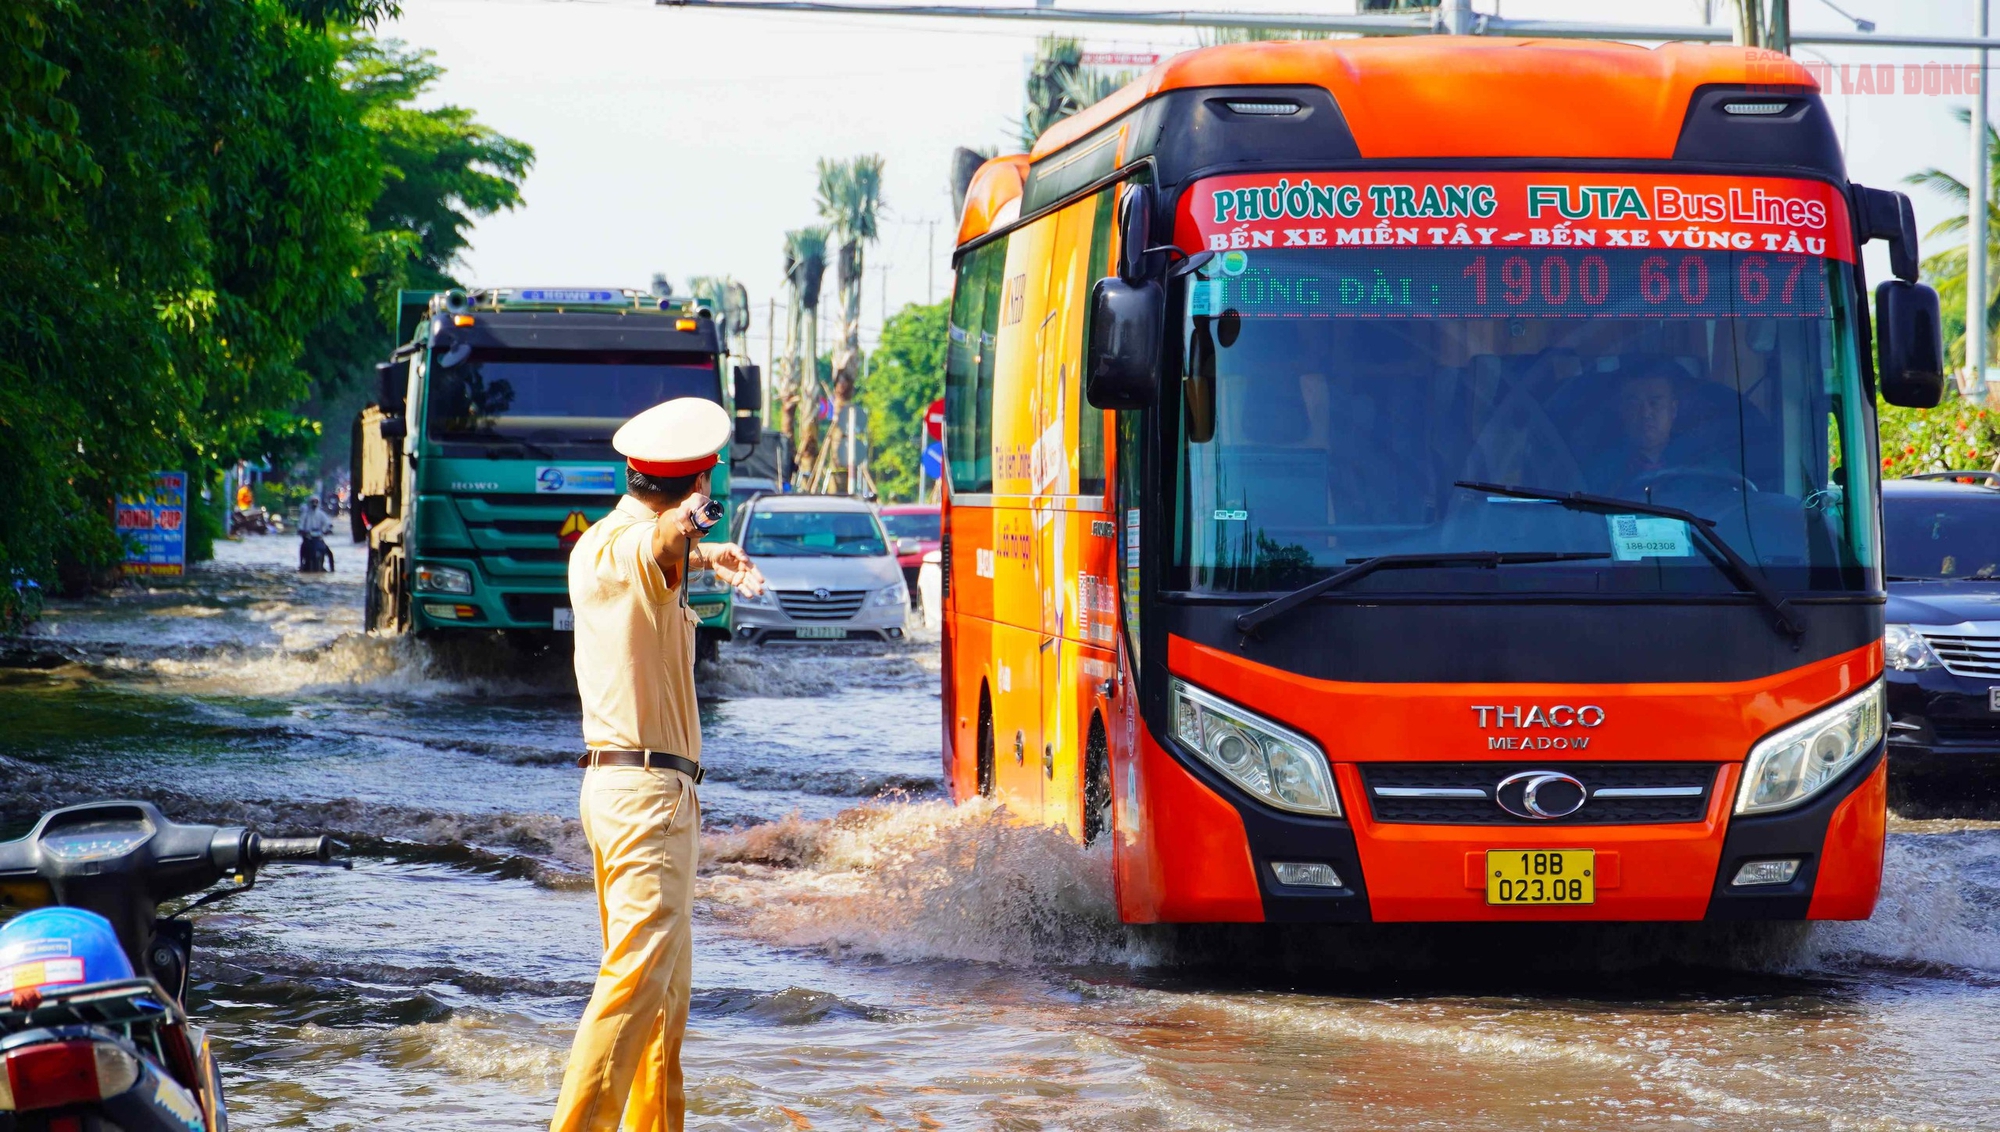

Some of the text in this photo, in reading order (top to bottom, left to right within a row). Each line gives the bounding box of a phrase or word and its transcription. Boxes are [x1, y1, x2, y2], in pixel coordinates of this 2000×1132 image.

[1213, 179, 1497, 222] PHƯƠNG TRANG
[1527, 185, 1826, 228] FUTA Bus Lines
[1208, 220, 1826, 254] BẾN XE MIỀN TÂY BẾN XE VŨNG TÀU
[1463, 256, 1609, 305] 1900
[1640, 256, 1709, 305] 60
[1739, 256, 1806, 305] 67
[451, 482, 498, 490] HOWO
[1471, 705, 1605, 728] THACO
[1488, 737, 1590, 750] MEADOW
[1521, 853, 1563, 876] 18B
[1499, 879, 1582, 901] 023.08
